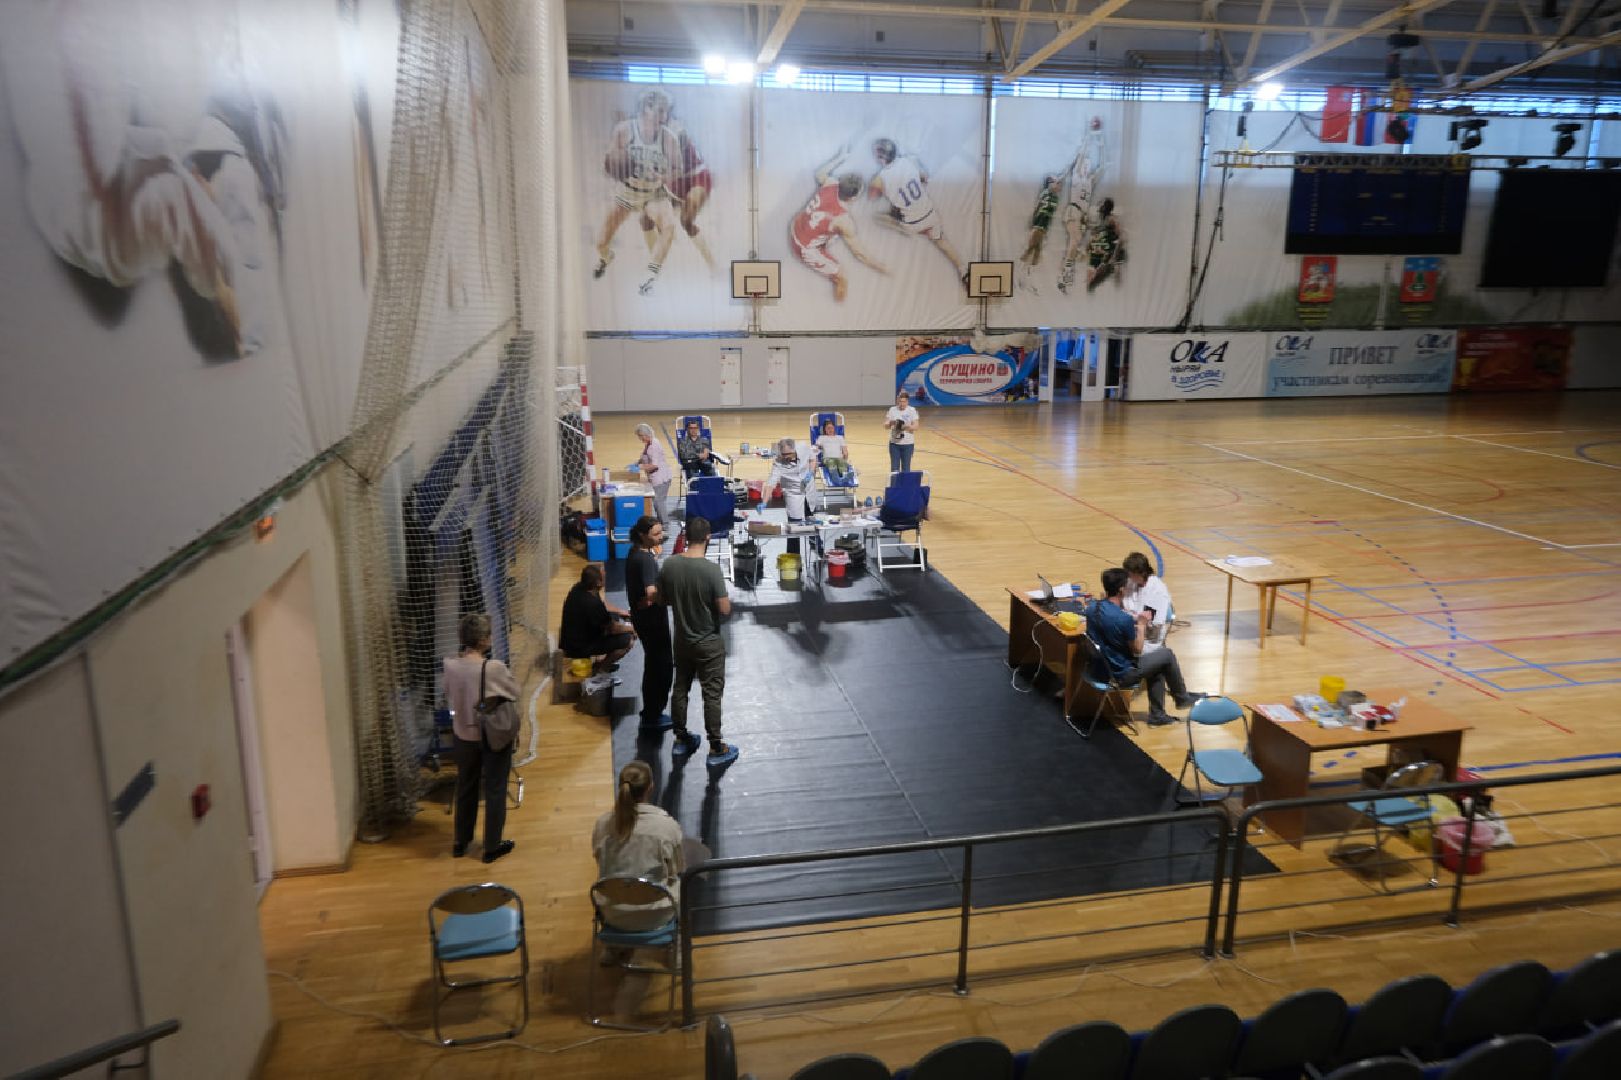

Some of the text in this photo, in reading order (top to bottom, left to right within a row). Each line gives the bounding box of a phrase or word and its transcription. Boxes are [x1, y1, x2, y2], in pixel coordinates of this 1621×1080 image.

[898, 178, 923, 208] 10
[1170, 339, 1230, 364] ОКА
[1328, 345, 1401, 365] ПРИВЕТ
[941, 363, 996, 378] ПУЩИНО
